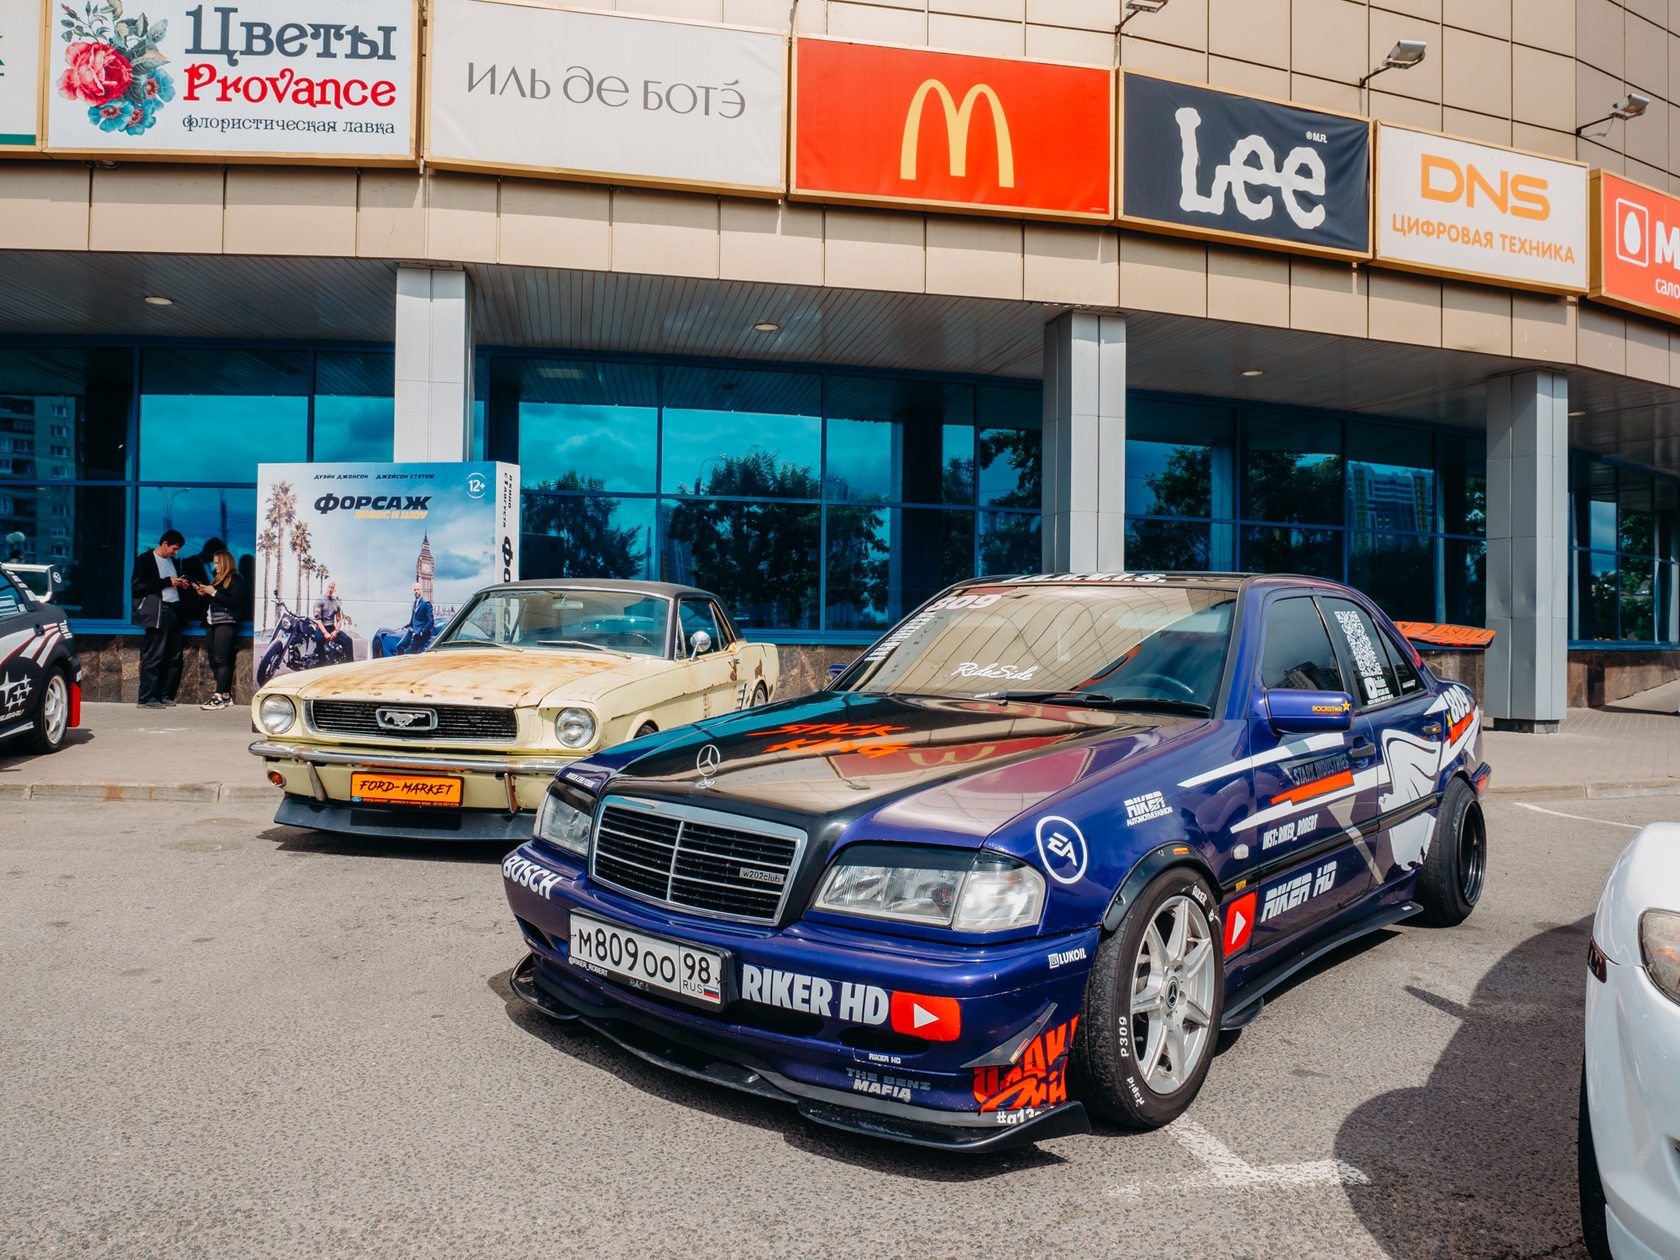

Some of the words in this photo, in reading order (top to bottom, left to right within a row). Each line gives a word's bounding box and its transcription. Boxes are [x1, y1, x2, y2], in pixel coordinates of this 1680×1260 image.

[185, 4, 397, 67] Цветы
[183, 63, 397, 110] Provance
[182, 114, 337, 133] флористическая
[342, 120, 395, 135] лавка
[1175, 107, 1326, 230] Lee
[1420, 153, 1551, 222] DNS
[1392, 213, 1494, 250] ЦИФРОВАЯ
[1499, 233, 1575, 264] ТЕХНИКА
[468, 479, 486, 492] 12+
[314, 493, 433, 514] ФОРСАЖ
[504, 855, 564, 900] BOSCH
[743, 870, 781, 883] w202club
[1058, 948, 1087, 965] LUKOIL
[683, 980, 703, 994] RUS
[742, 963, 833, 1017] RIKER
[840, 981, 889, 1025] HD
[846, 1067, 877, 1082] THE
[883, 1075, 931, 1091] BENZ
[853, 1079, 911, 1100] MAFIA
[1126, 1076, 1145, 1107] Rapid
